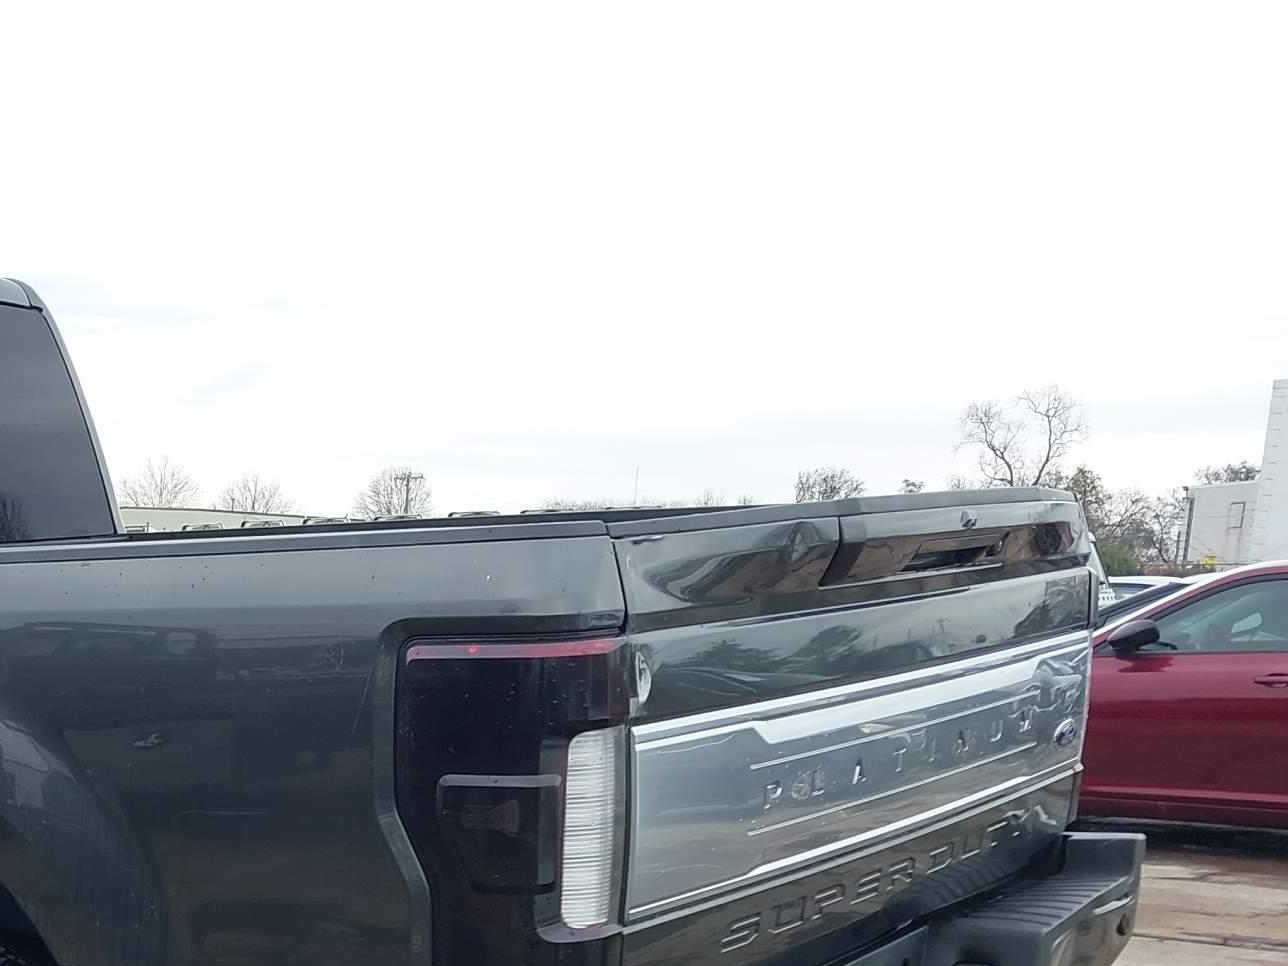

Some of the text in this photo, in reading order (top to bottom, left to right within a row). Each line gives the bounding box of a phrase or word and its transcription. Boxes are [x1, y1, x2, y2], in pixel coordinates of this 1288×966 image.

[763, 708, 1032, 810] PLATINUM
[719, 808, 1031, 954] SUPER DUTY
